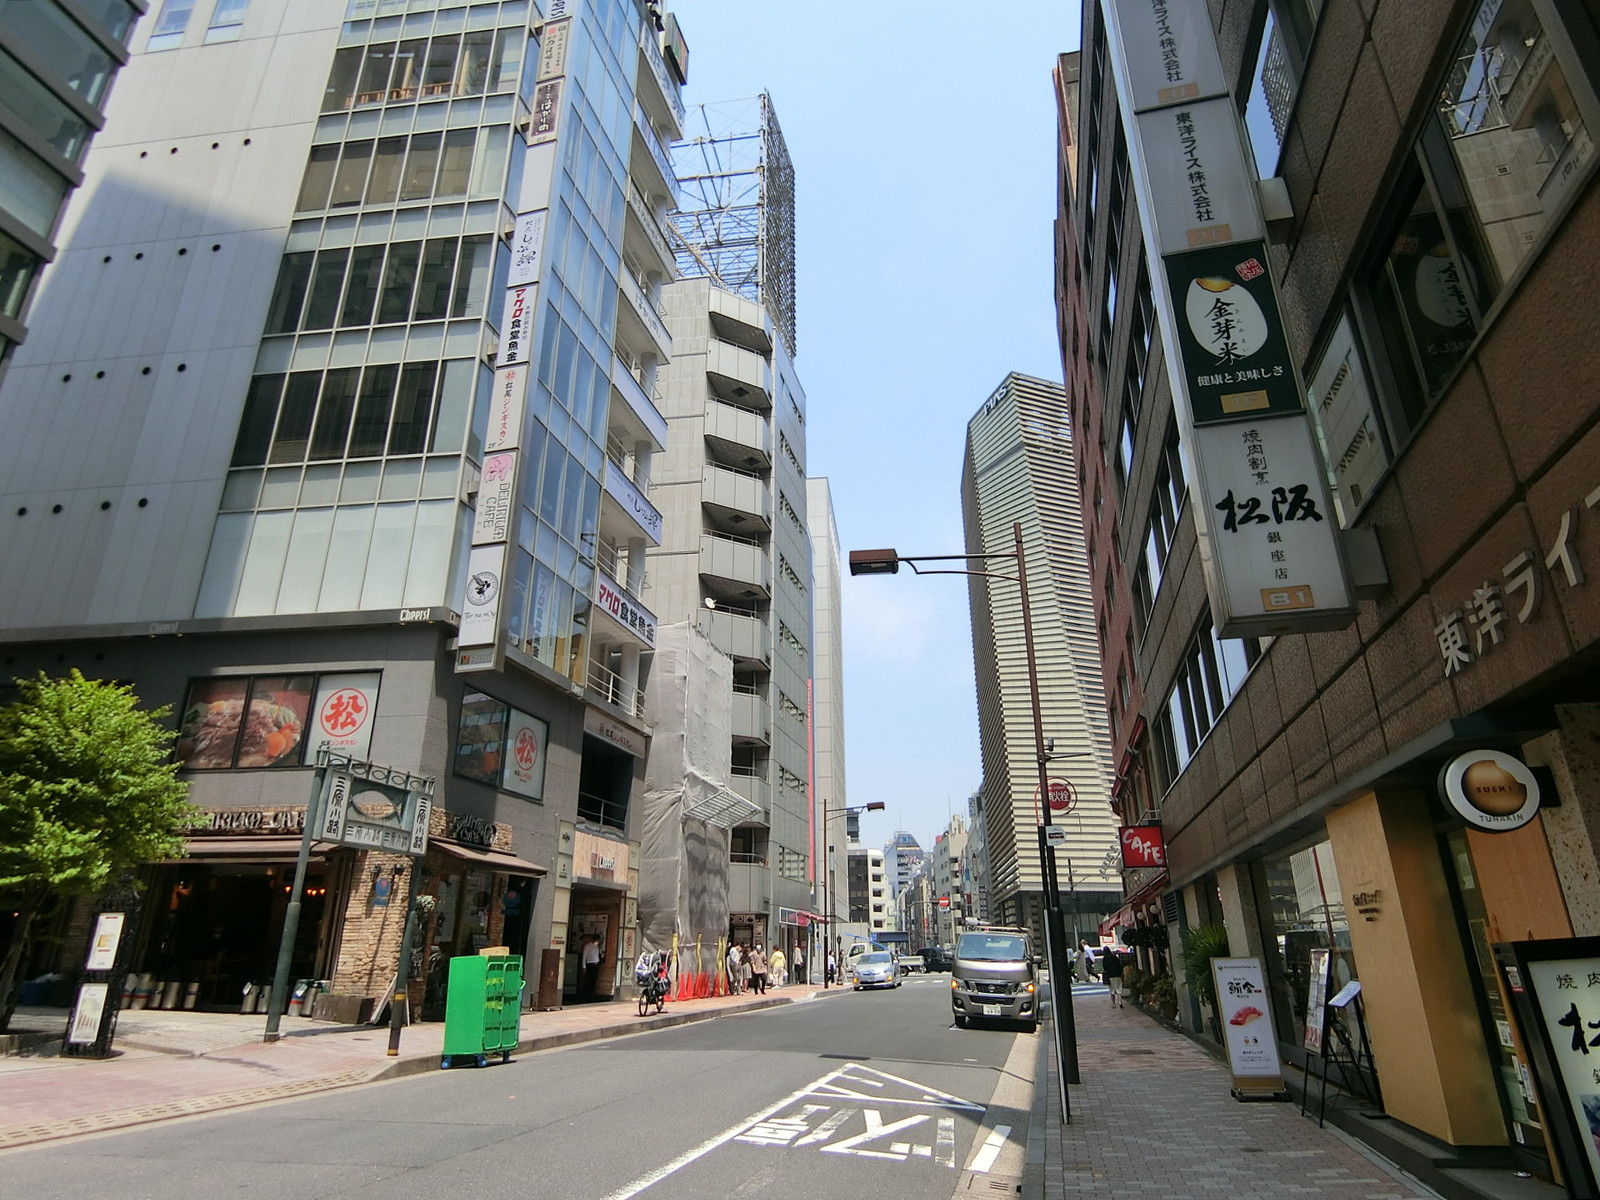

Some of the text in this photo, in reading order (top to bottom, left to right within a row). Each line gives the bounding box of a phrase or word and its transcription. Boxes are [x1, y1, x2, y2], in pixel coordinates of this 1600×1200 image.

[1175, 111, 1215, 222] 東洋ライス株式会社
[506, 288, 526, 362] マグロ食堂魚金
[1204, 297, 1248, 366] 金芽米
[1197, 365, 1284, 387] 健康と美味しさ
[1242, 429, 1269, 485] 焼肉割烹
[1215, 484, 1324, 533] 松阪
[1266, 530, 1288, 581] 銀座店
[1268, 588, 1309, 606] B1
[1434, 487, 1600, 677] 東洋ライ
[400, 608, 430, 621] Cheers!
[325, 694, 364, 731] 松
[516, 731, 536, 765] 松
[326, 776, 346, 840] 三原小路
[1476, 785, 1513, 794] SUSHI
[1479, 813, 1524, 823] TUNAKIN
[1122, 828, 1164, 865] CAFE
